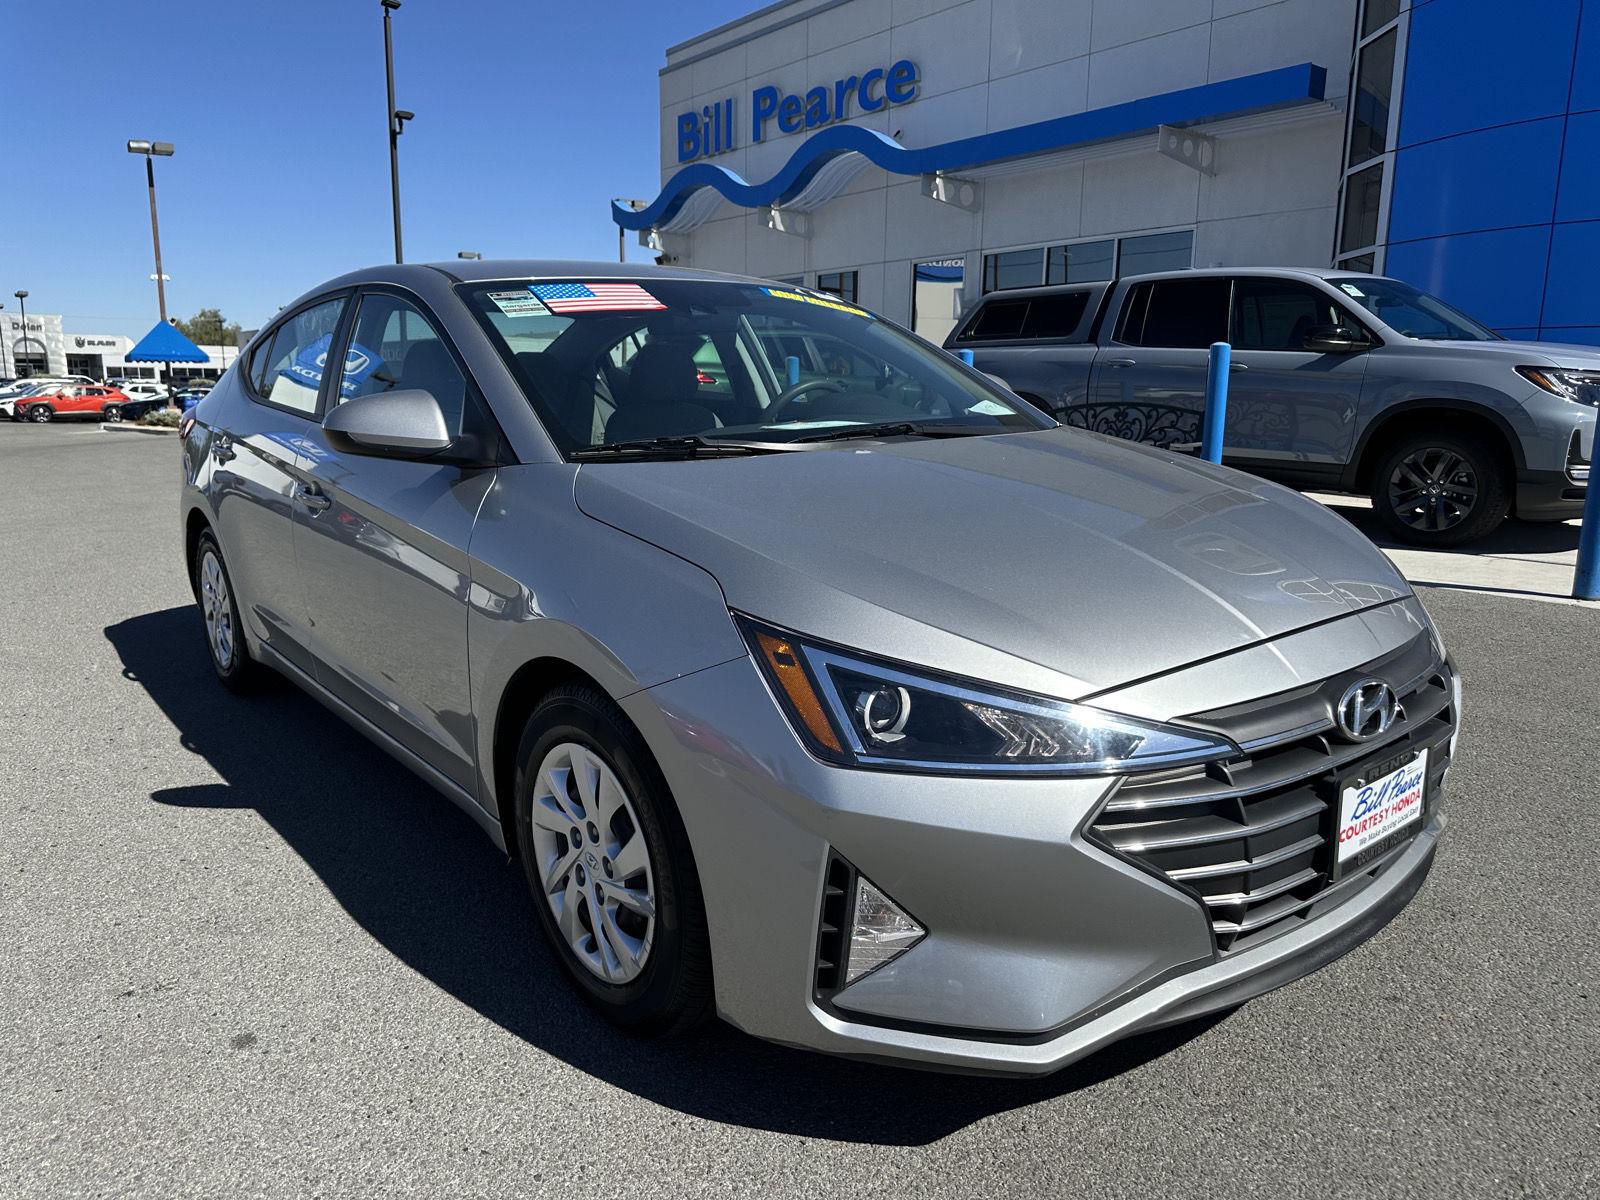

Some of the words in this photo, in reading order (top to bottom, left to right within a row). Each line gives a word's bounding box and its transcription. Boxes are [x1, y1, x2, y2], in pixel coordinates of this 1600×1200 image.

[677, 98, 733, 163] Bill
[752, 59, 917, 143] Pearce
[12, 322, 42, 331] Dolan
[1368, 752, 1411, 780] RENO
[1351, 786, 1391, 821] Bill
[1388, 769, 1424, 803] Pearce
[1338, 806, 1391, 843] COURTESY
[1391, 788, 1421, 816] HONDA
[1357, 837, 1390, 866] COURTESY
